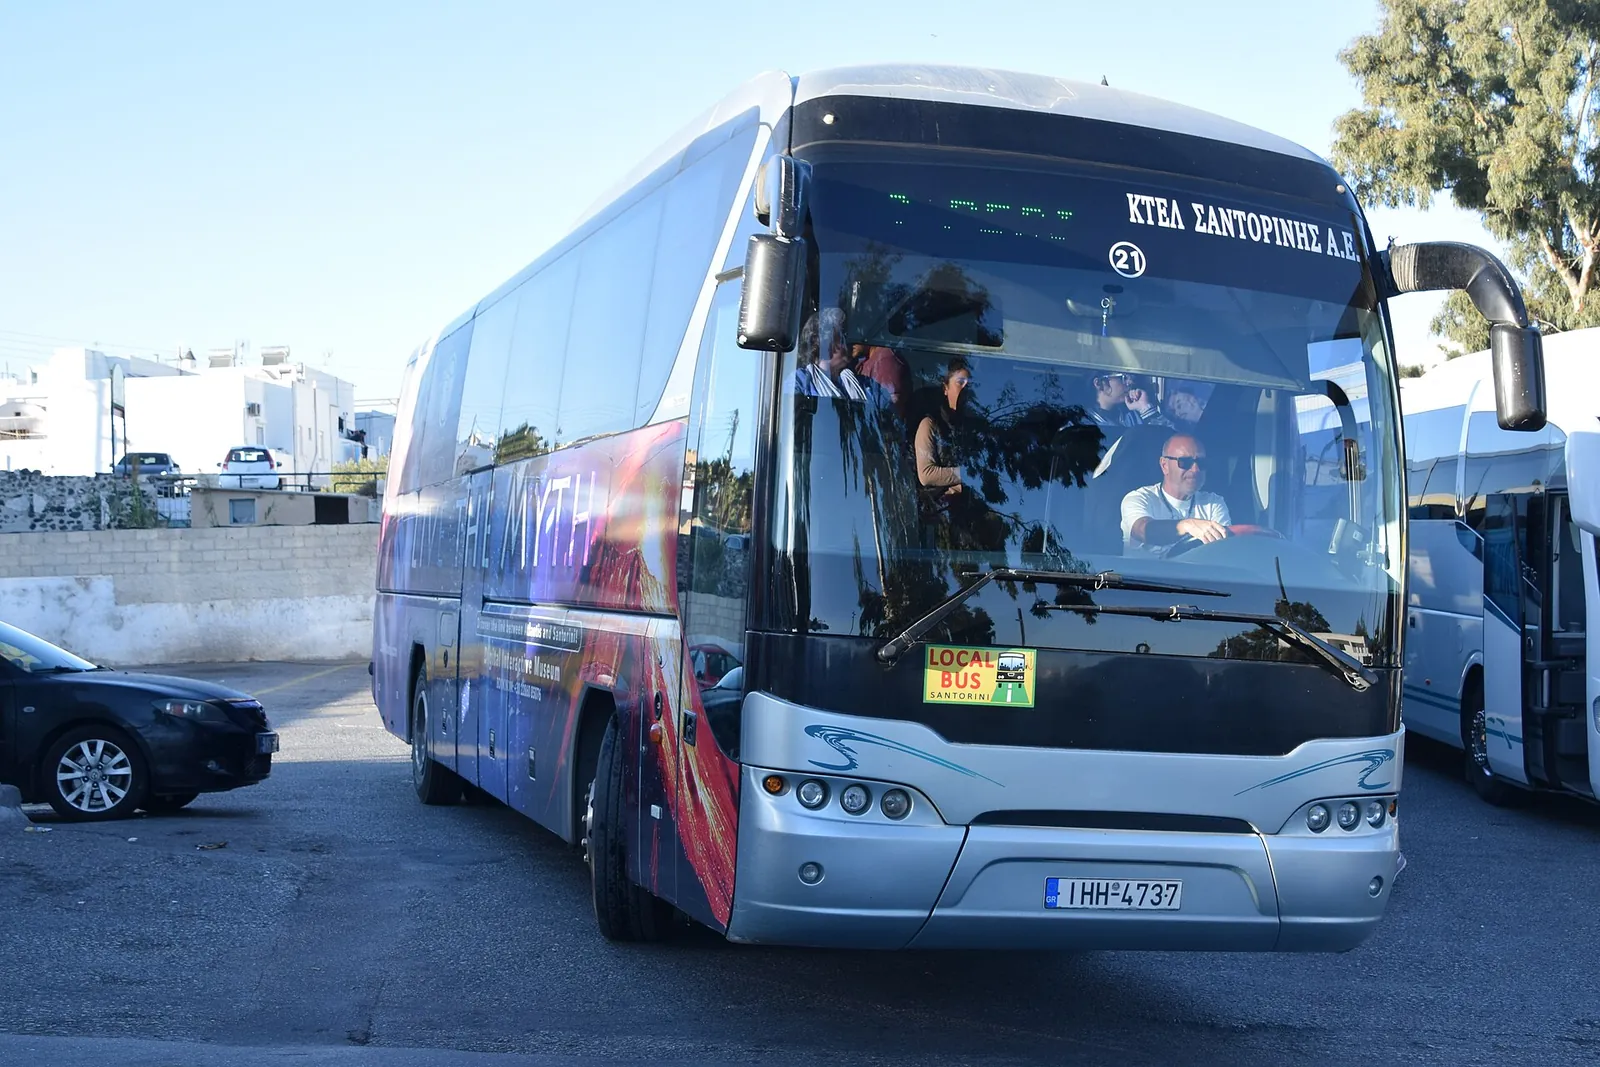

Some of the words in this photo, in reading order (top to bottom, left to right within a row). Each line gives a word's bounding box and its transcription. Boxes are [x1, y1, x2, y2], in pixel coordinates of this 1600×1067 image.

[1126, 193, 1185, 230] ΚΤΕΛ
[1191, 203, 1322, 254] ΣΑΝΤΟΡΙΝΗΣ
[1115, 249, 1141, 272] 21
[500, 468, 596, 570] MYTH
[543, 625, 552, 640] and
[553, 626, 578, 644] Santorini!
[534, 655, 561, 682] Museum
[929, 648, 995, 669] LOCAL
[941, 671, 981, 690] BUS
[930, 691, 990, 701] SANTORINI
[1046, 895, 1057, 904] GR
